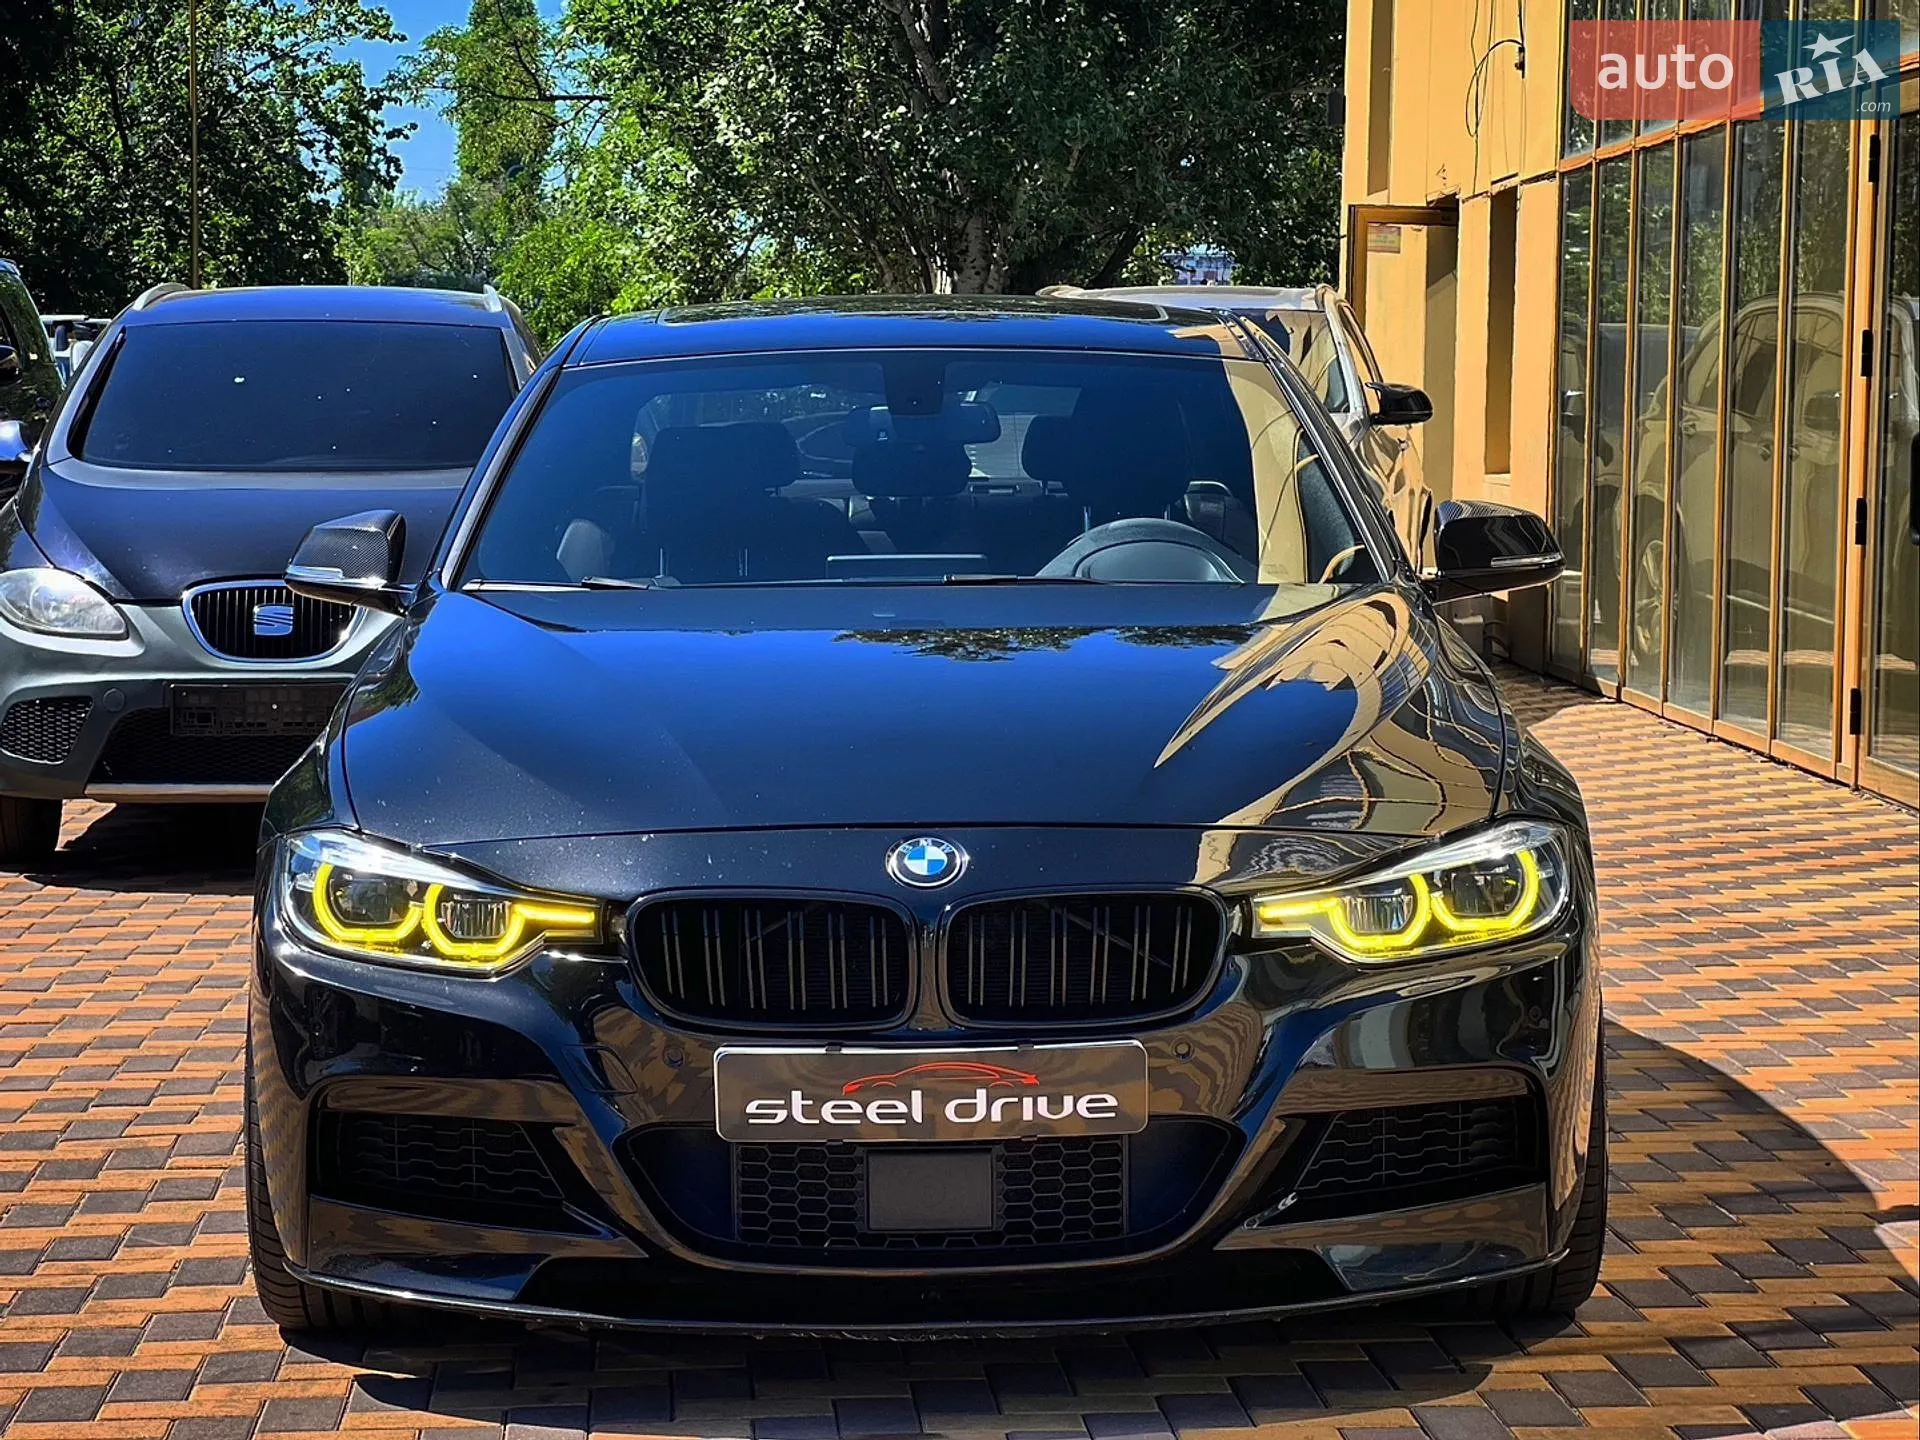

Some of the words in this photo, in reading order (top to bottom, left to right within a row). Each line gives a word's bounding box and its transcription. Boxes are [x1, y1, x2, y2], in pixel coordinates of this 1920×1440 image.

[900, 839, 953, 855] BMW
[745, 1090, 922, 1125] steel
[944, 1088, 1119, 1124] drive
